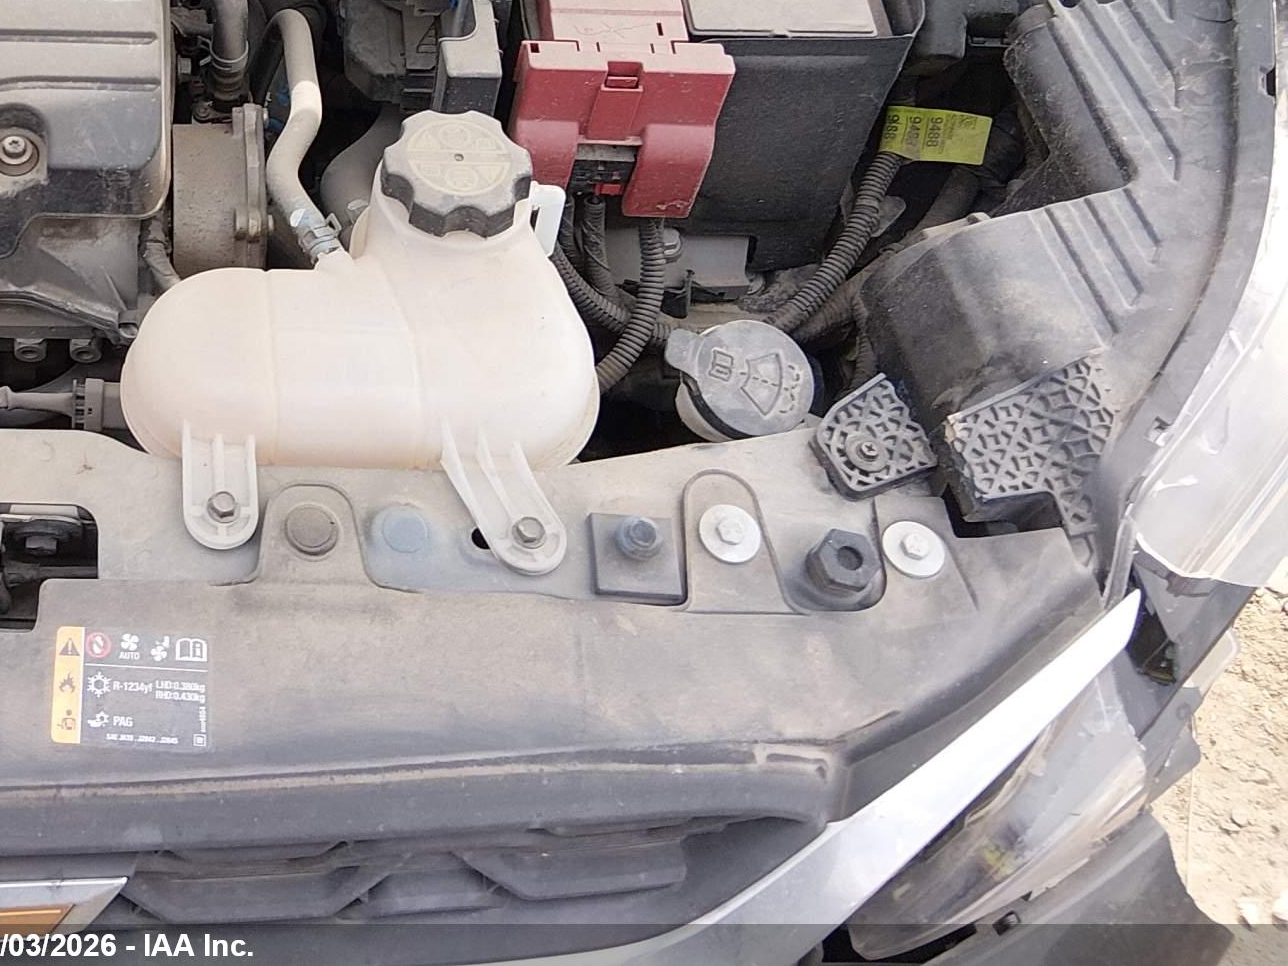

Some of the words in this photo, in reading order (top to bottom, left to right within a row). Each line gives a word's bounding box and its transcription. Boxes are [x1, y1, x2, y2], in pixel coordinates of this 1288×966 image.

[926, 117, 943, 147] 9488
[119, 652, 140, 660] AUTO
[113, 681, 152, 694] R-1234yf
[113, 715, 133, 727] PAG
